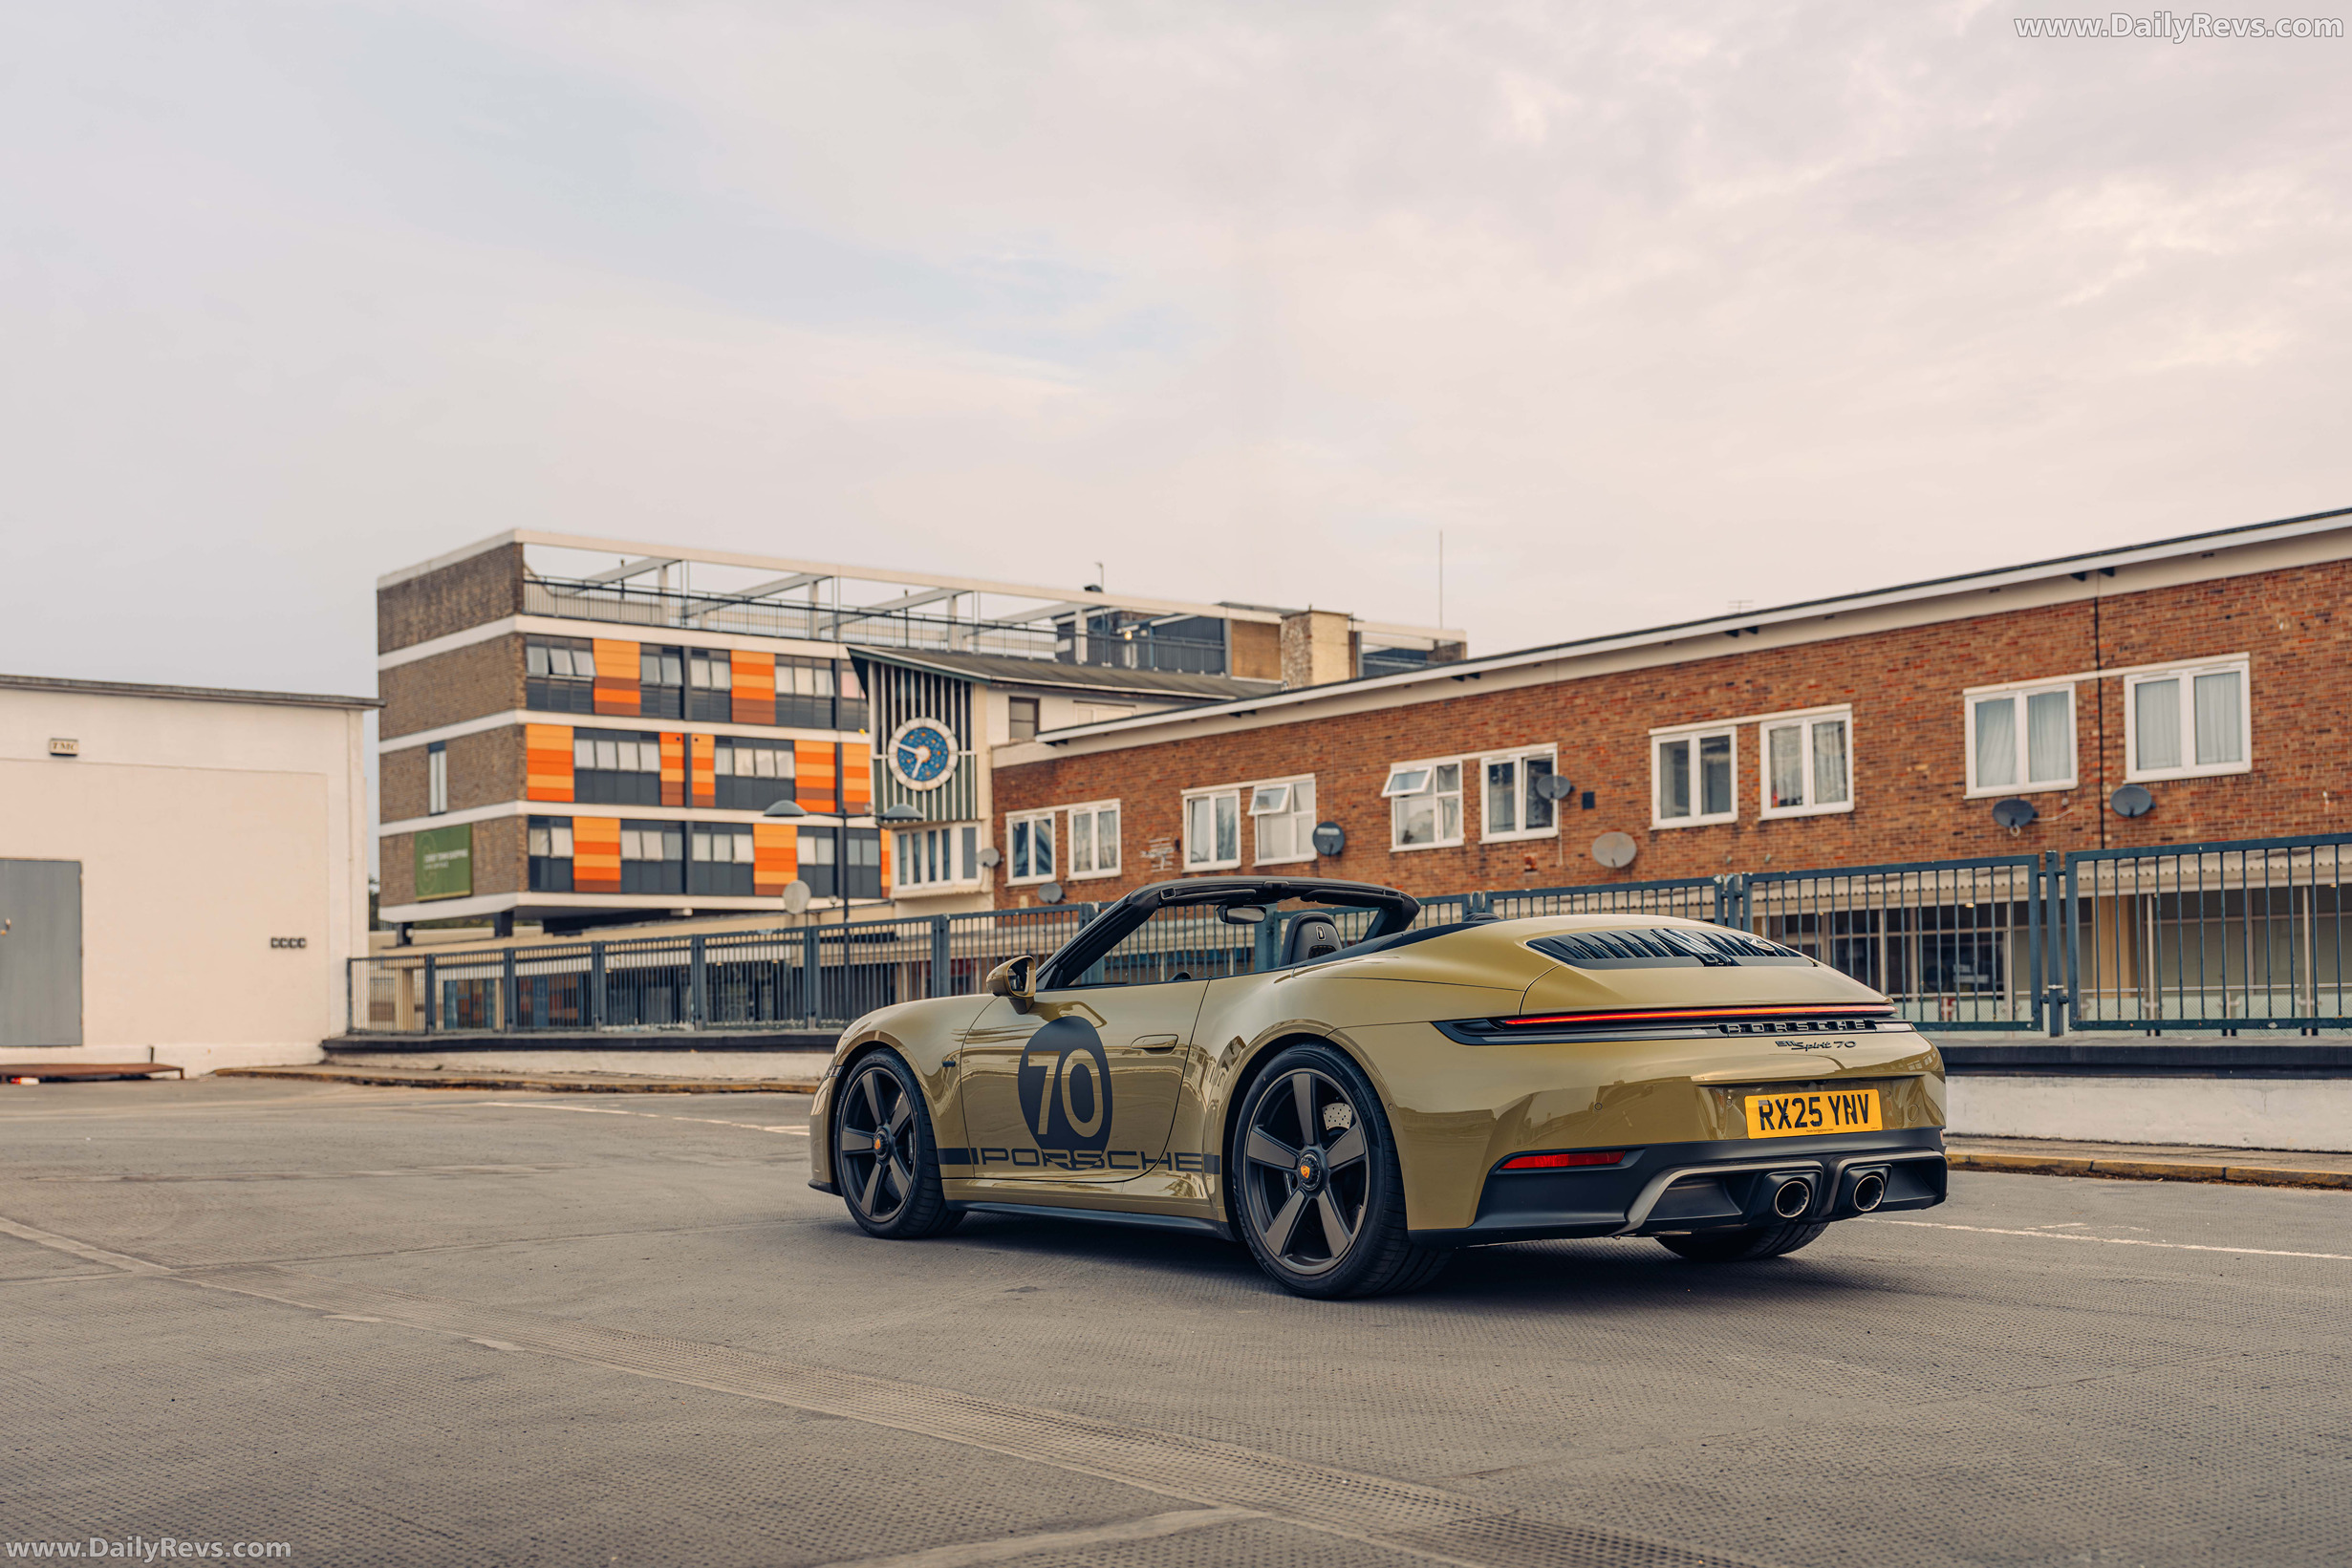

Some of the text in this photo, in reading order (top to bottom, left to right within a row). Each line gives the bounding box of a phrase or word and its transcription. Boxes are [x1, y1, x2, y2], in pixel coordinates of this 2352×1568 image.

[1727, 1020, 1866, 1034] PORSCHE
[1791, 1041, 1832, 1052] Spirit
[1027, 1048, 1104, 1138] 70
[1758, 1094, 1869, 1131] RX25 YNV
[980, 1148, 1203, 1172] PORSCHE
